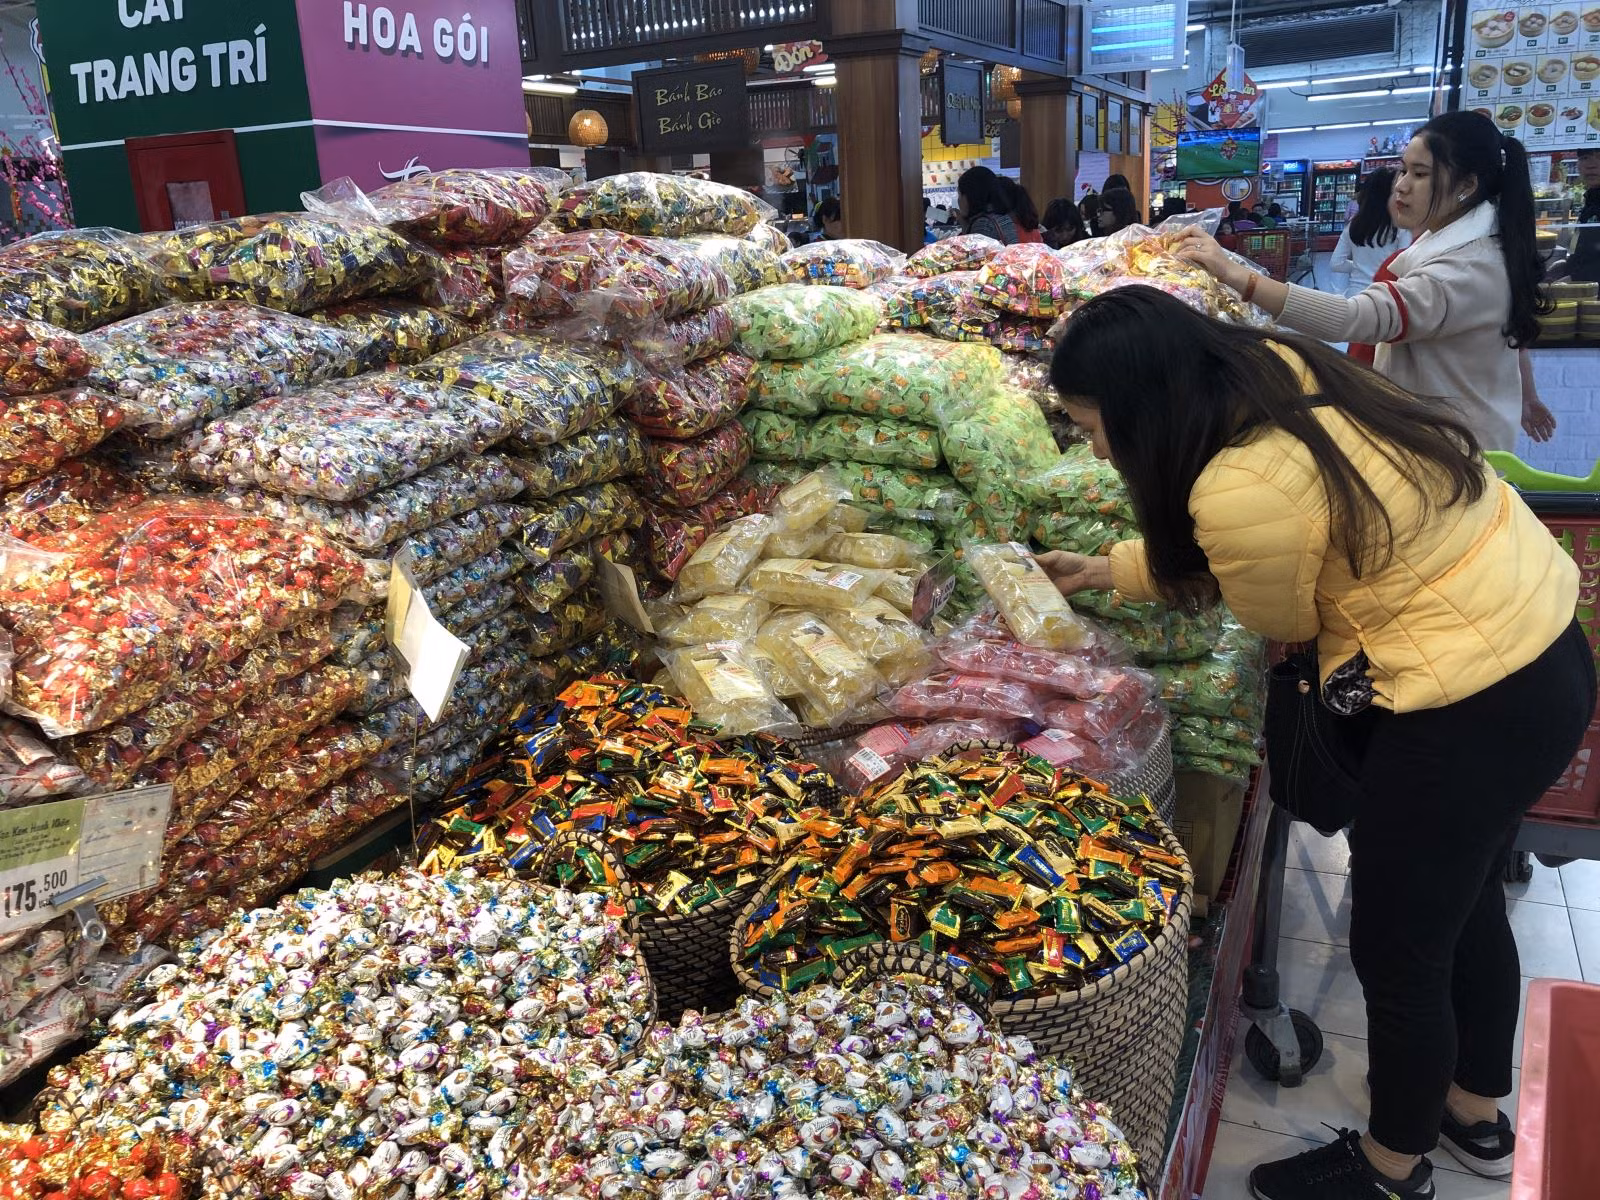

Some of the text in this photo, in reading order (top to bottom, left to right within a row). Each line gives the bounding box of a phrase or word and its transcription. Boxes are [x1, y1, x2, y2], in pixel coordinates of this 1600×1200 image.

[344, 1, 488, 63] HOA GÓI
[70, 24, 267, 104] TRANG TRÍ
[655, 82, 723, 106] Bánh Bao
[658, 111, 693, 135] Bánh
